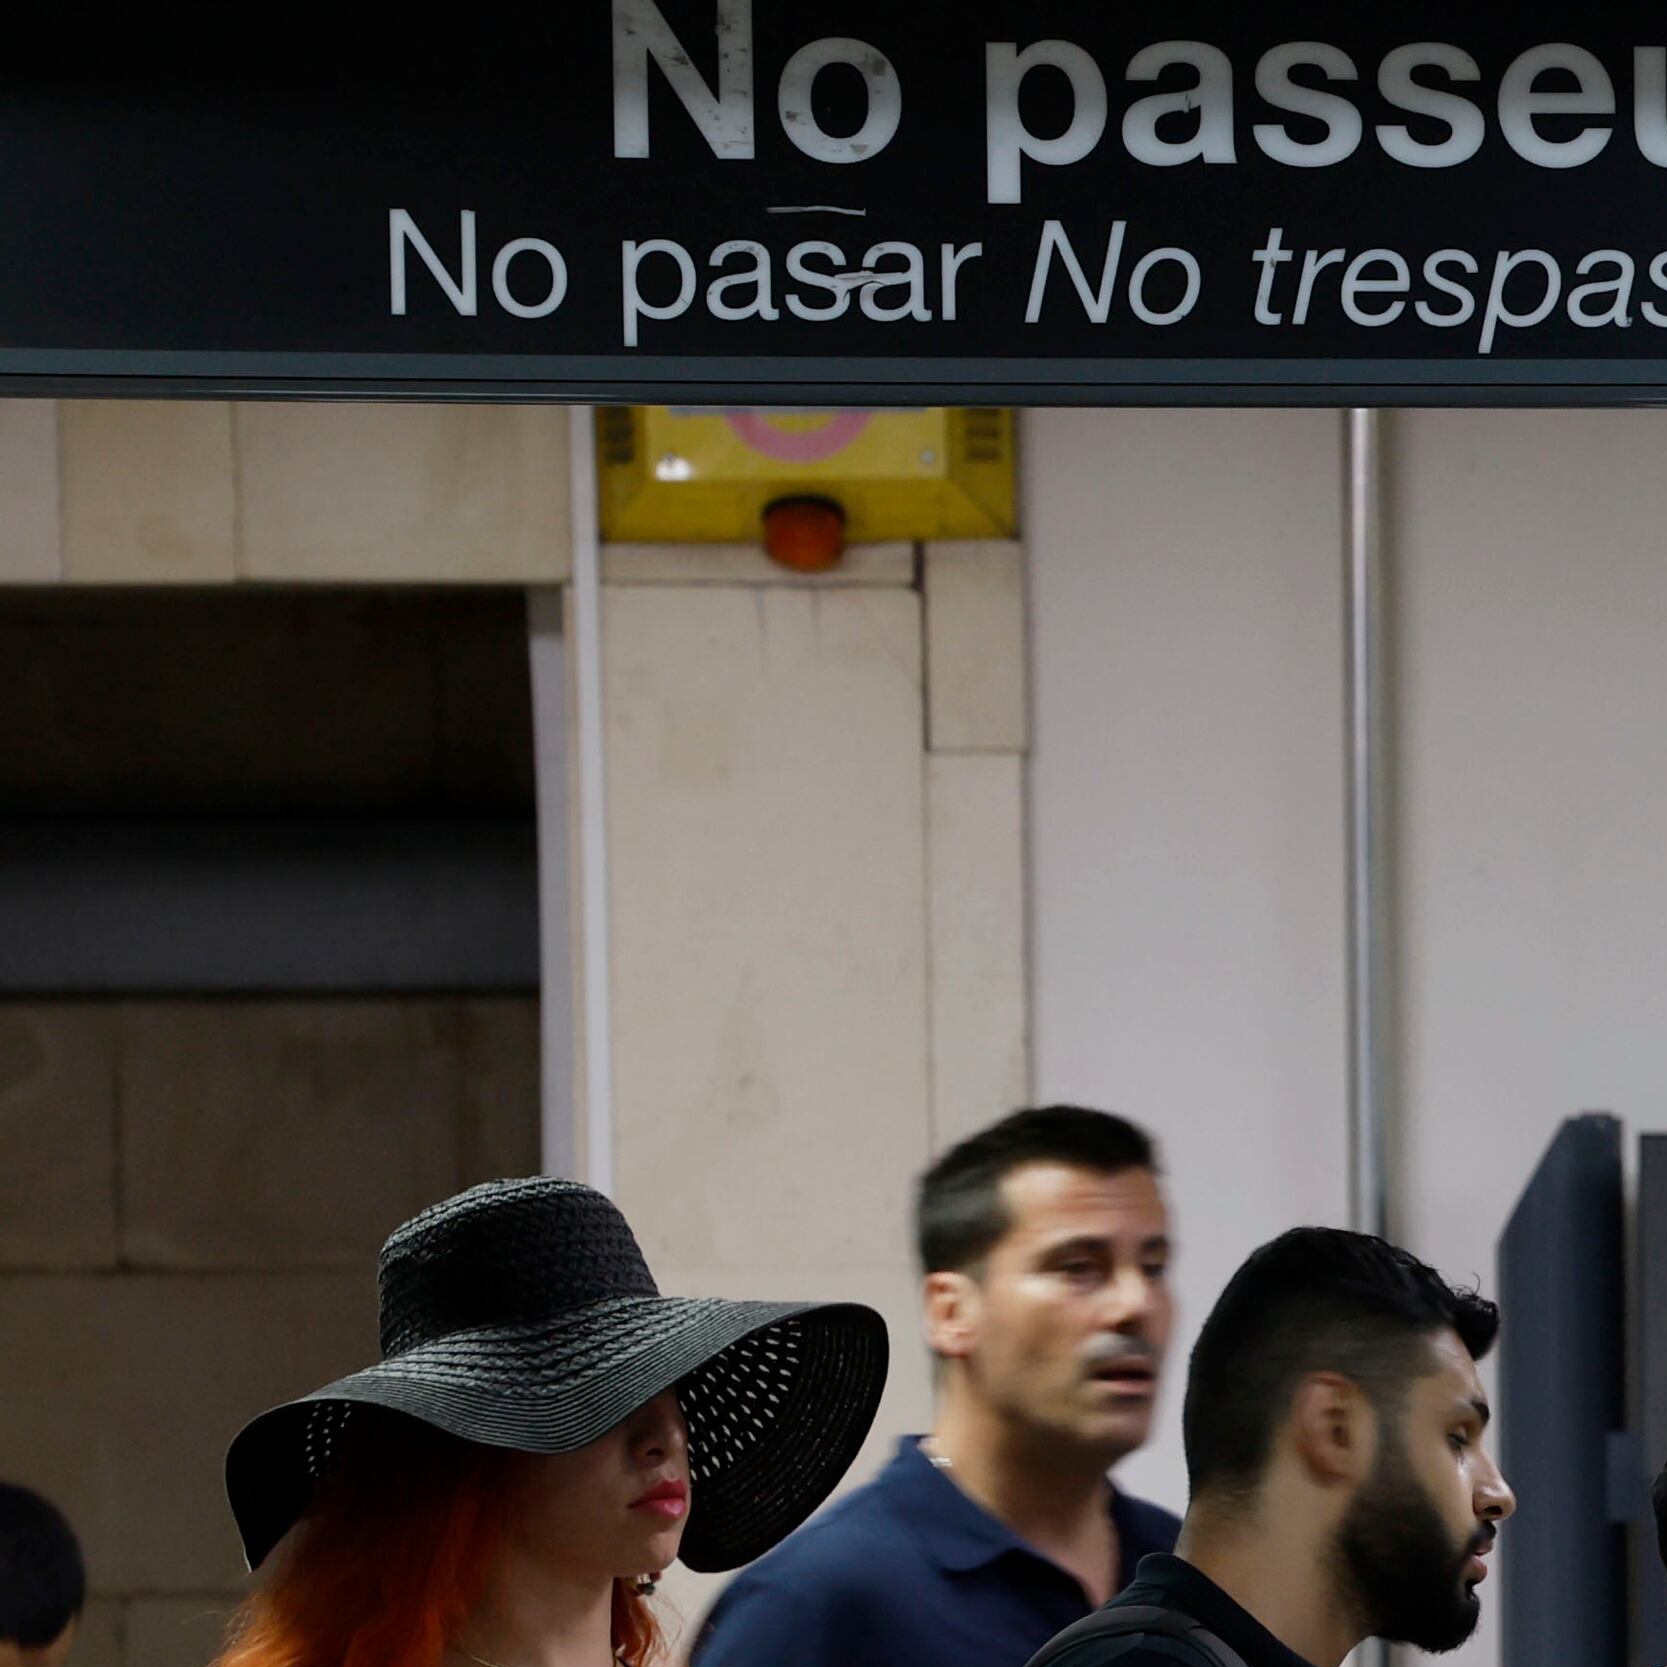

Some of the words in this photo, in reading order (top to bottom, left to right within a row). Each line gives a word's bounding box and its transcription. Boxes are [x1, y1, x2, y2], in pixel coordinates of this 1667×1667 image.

[611, 0, 904, 165] No
[388, 208, 568, 320] No
[621, 236, 983, 347] pasar
[1024, 218, 1201, 326] No
